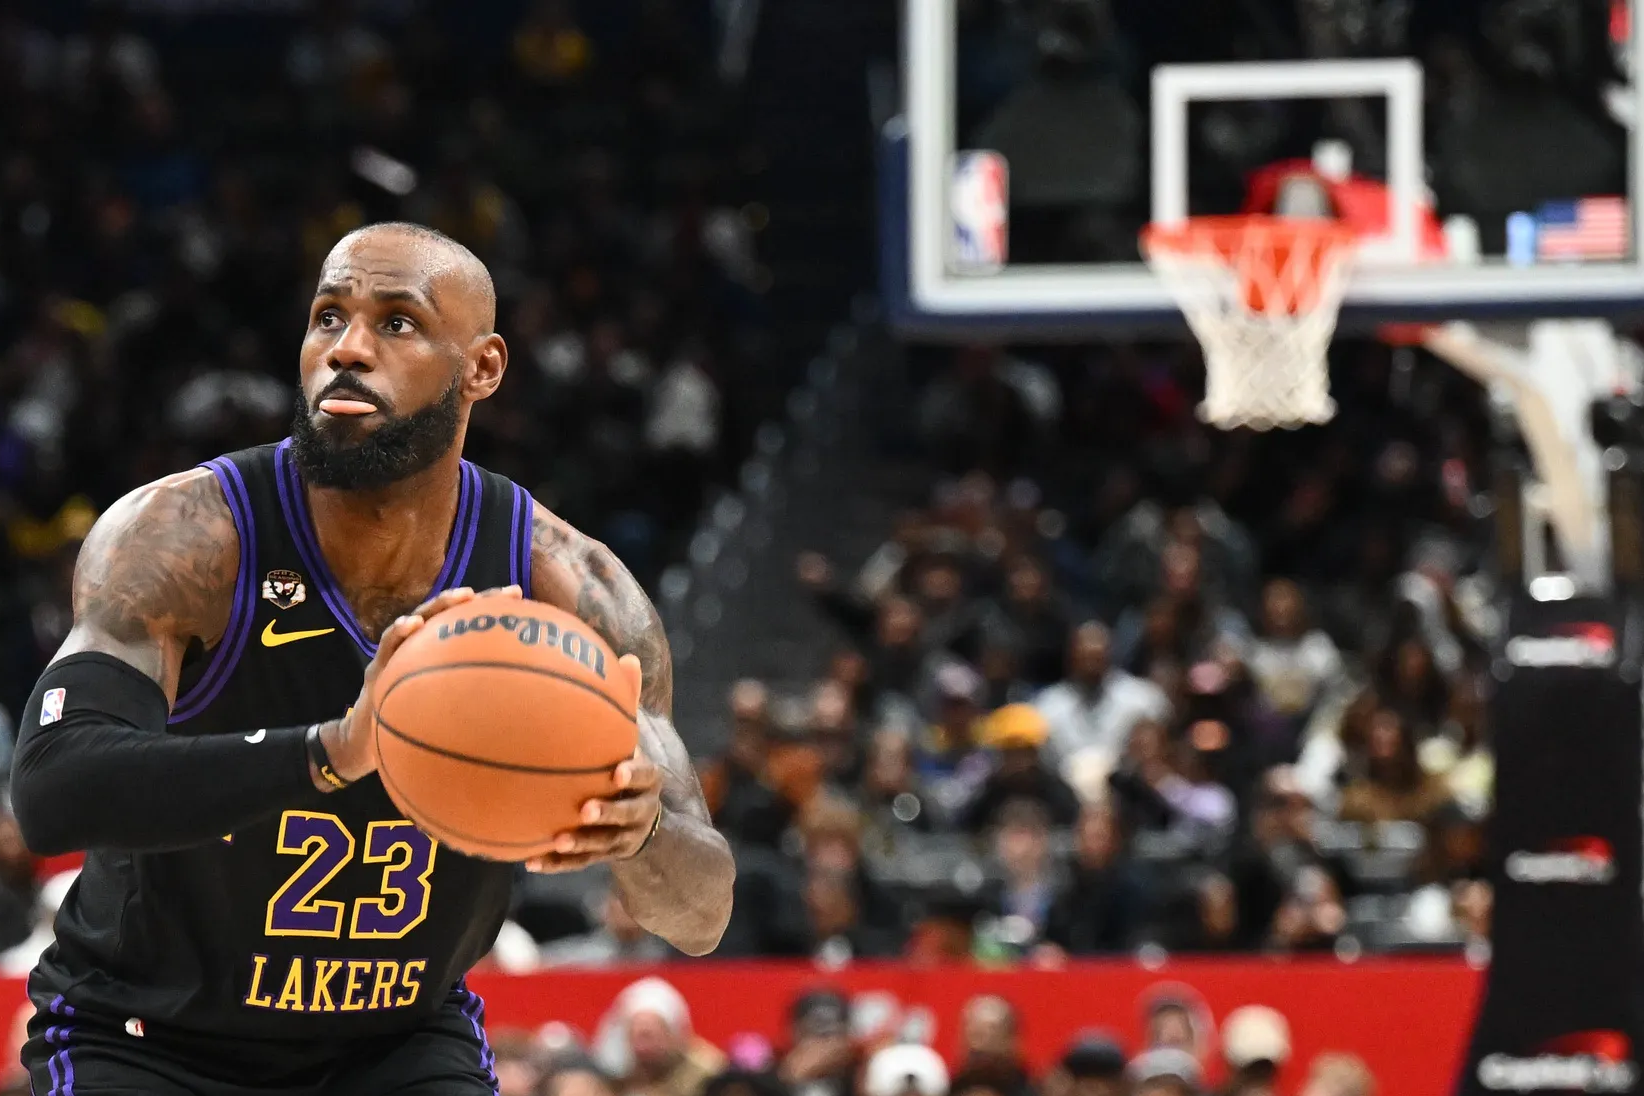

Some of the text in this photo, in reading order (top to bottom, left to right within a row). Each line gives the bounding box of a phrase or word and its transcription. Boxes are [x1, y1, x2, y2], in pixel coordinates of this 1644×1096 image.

[438, 604, 606, 680] Wilson
[264, 809, 439, 940] 23
[244, 953, 428, 1014] LAKERS
